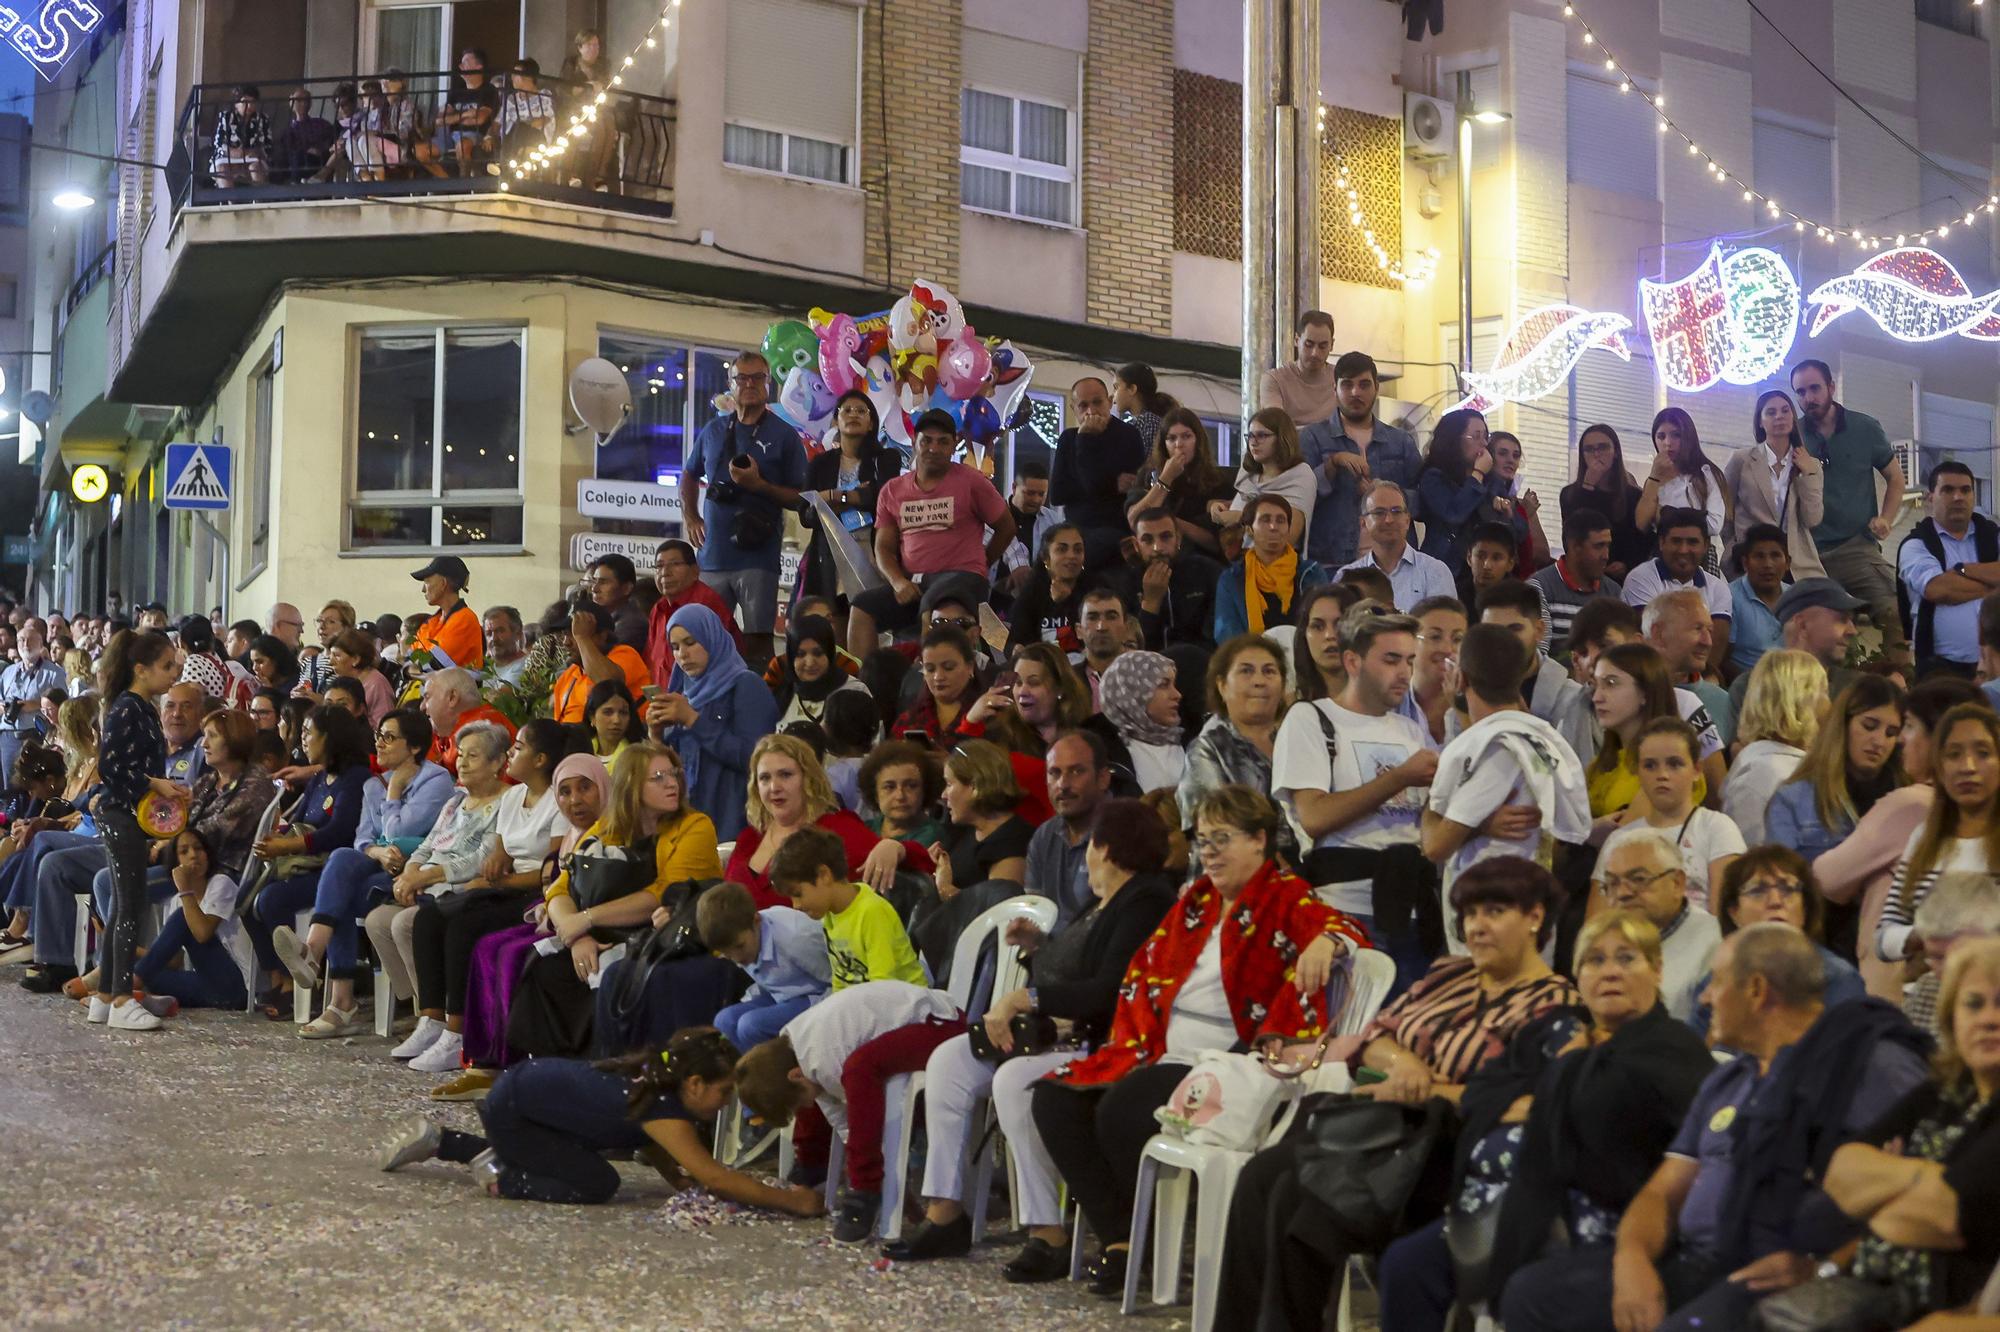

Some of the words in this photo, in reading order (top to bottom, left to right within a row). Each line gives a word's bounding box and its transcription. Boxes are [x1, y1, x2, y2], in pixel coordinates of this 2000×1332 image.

[584, 486, 636, 507] Colegio
[927, 502, 949, 511] YORK
[904, 515, 924, 523] NEW
[926, 513, 949, 521] YORK
[584, 538, 624, 553] Centre
